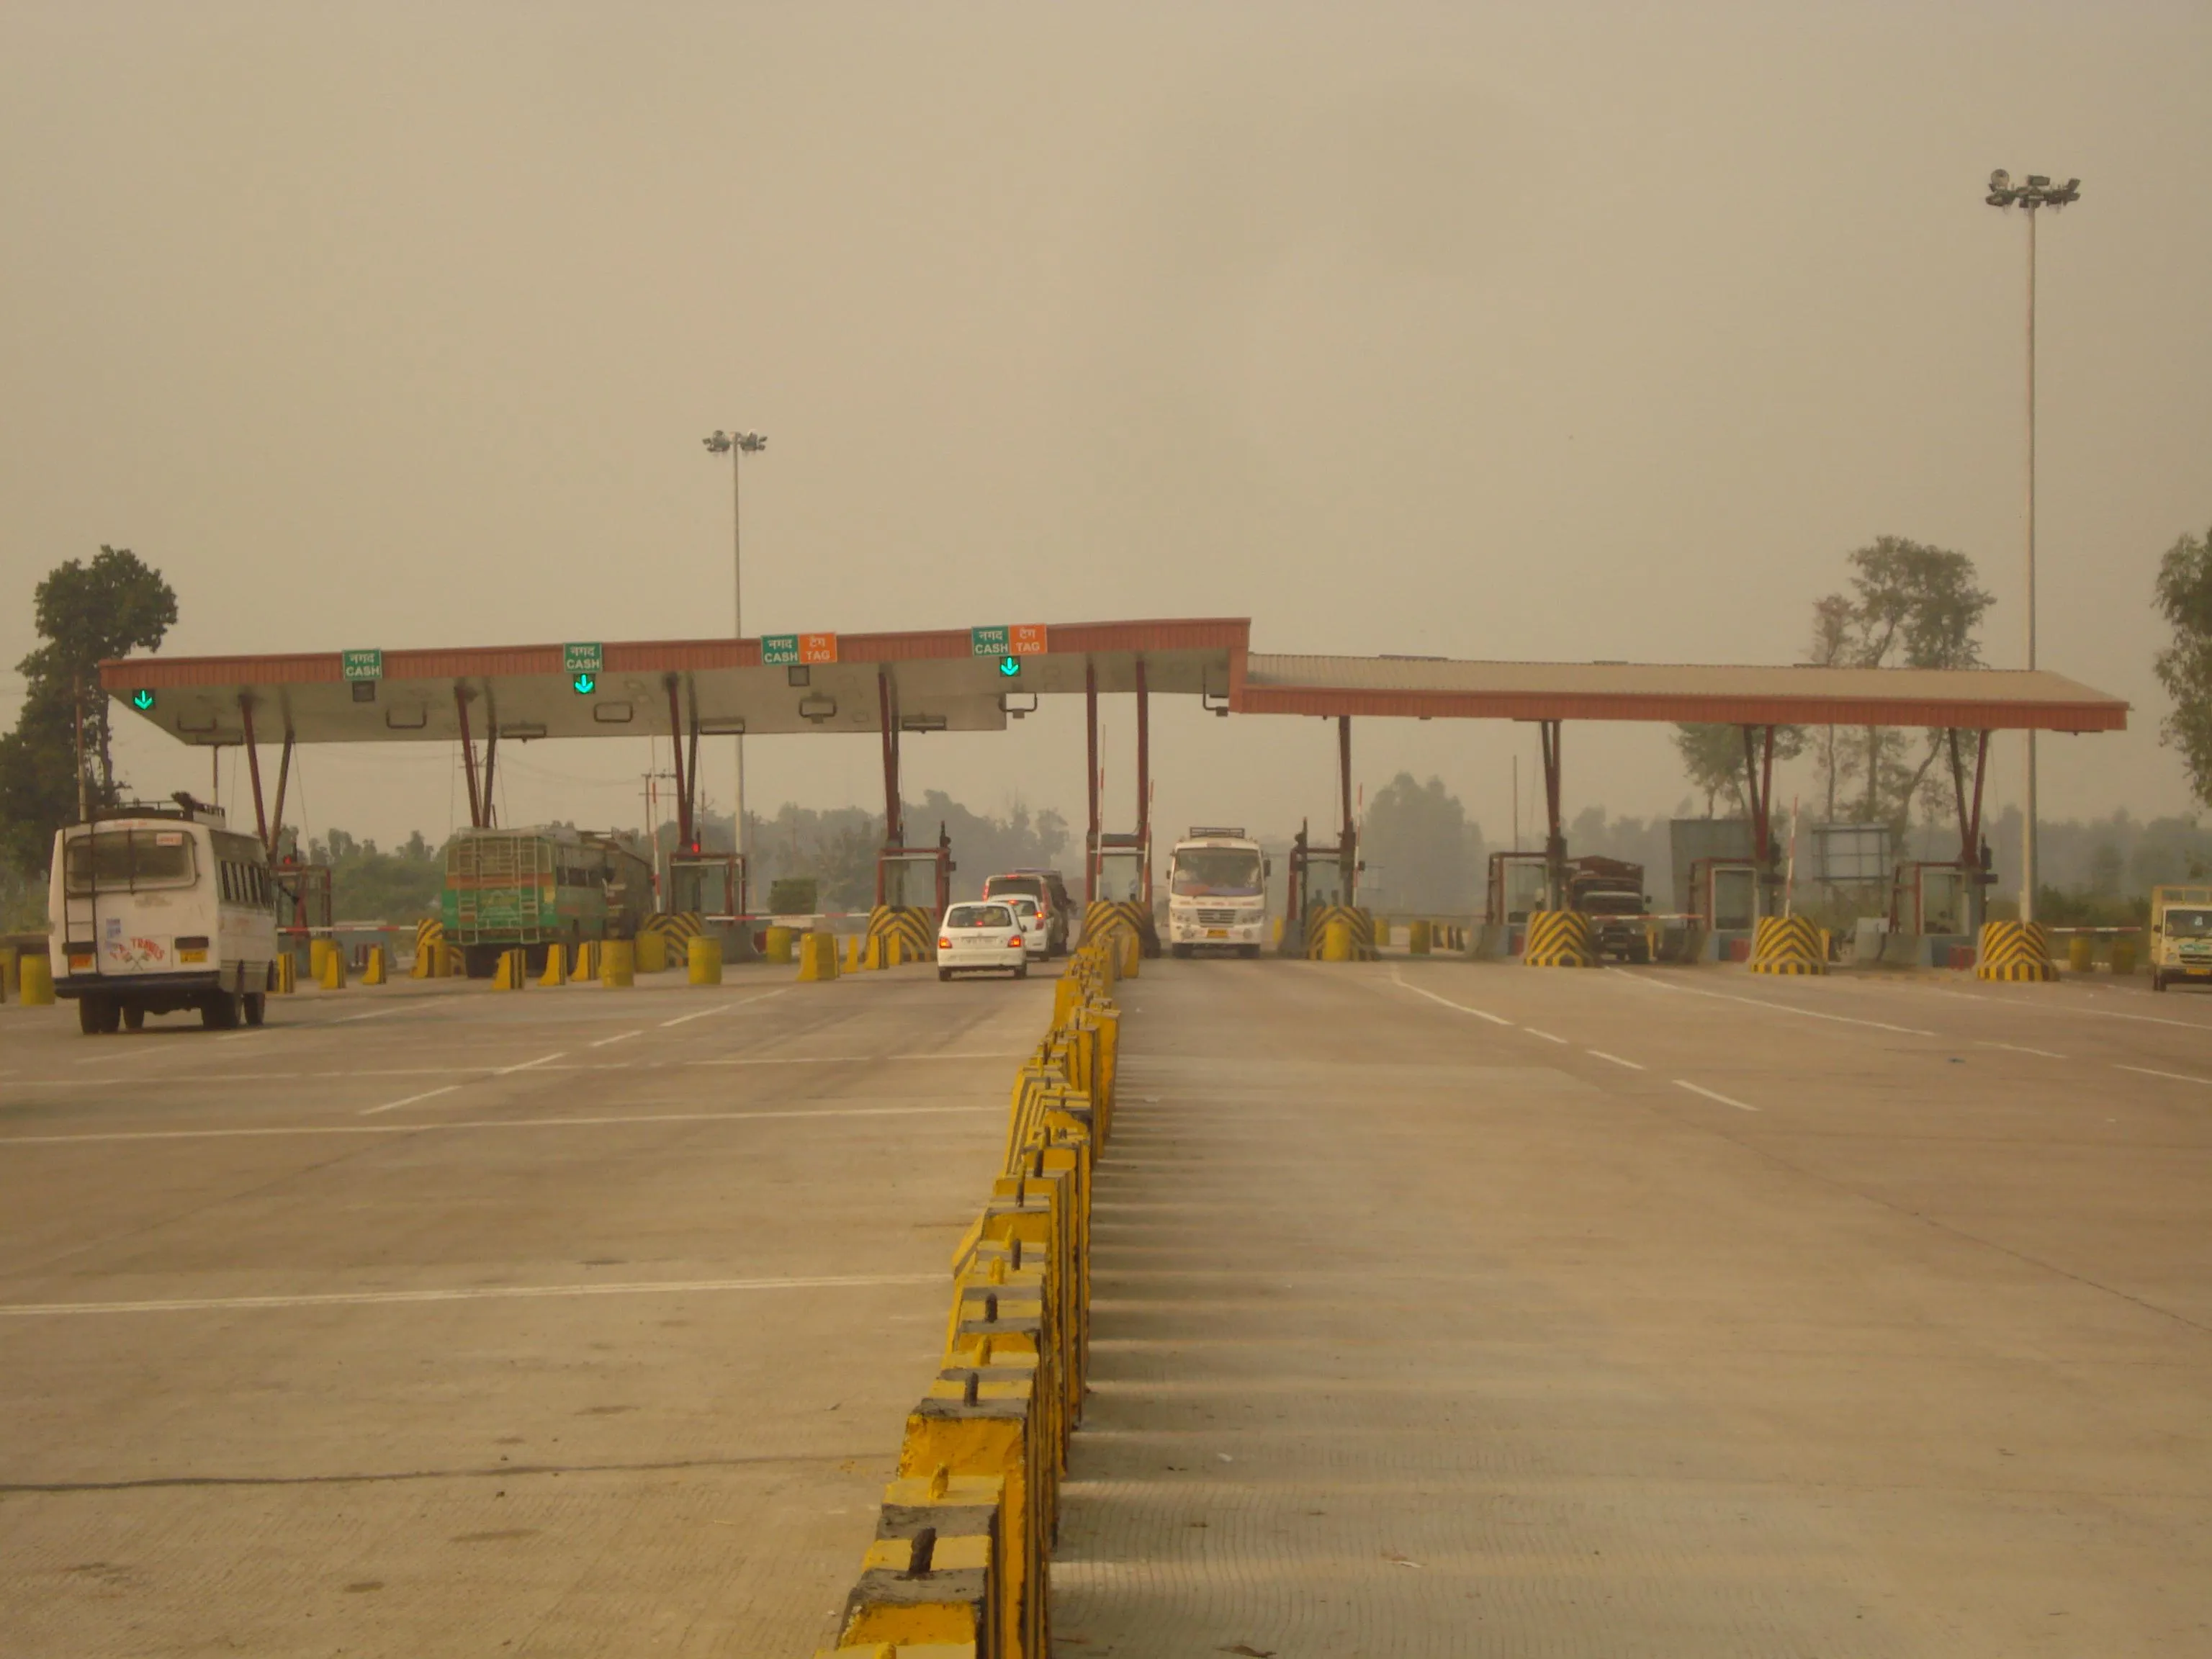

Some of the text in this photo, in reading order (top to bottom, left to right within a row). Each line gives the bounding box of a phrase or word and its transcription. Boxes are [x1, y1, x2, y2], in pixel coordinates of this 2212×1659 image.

[976, 643, 1008, 655] CASH
[1016, 642, 1040, 652] TAG
[765, 651, 798, 662] CASH
[806, 650, 830, 660] TAG
[567, 659, 599, 669] CASH
[346, 666, 379, 677] CASH
